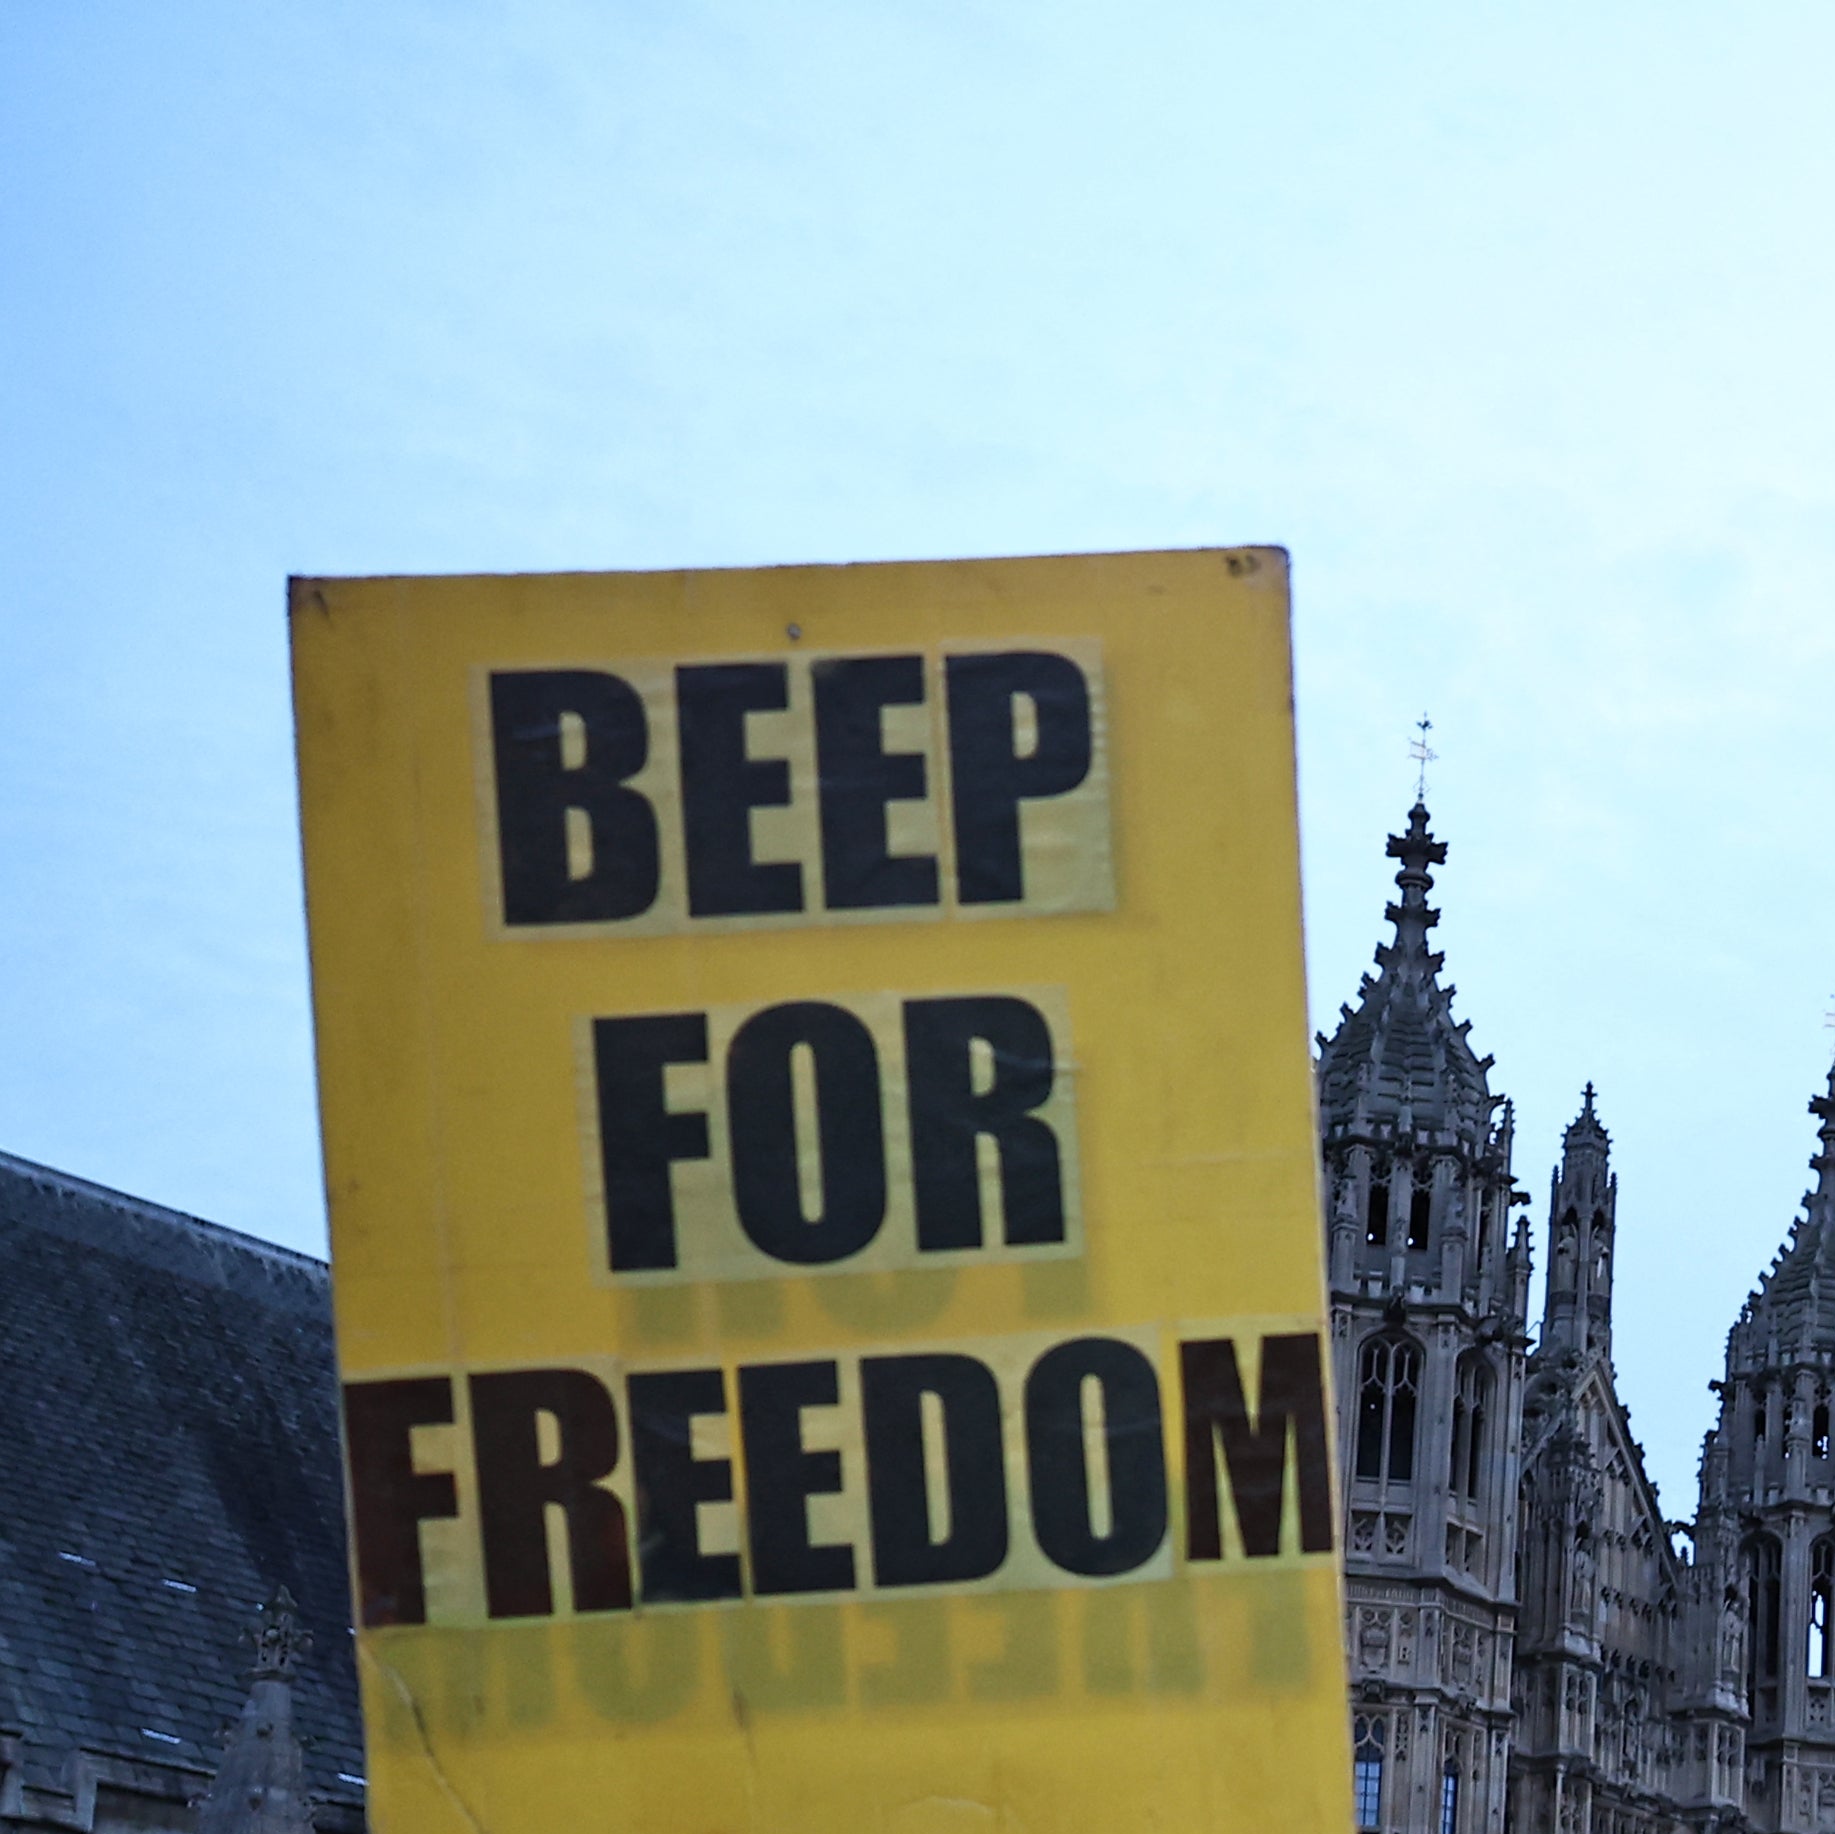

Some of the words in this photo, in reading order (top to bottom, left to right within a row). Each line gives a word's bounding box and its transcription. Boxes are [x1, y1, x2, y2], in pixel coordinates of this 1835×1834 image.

[488, 650, 1092, 925] BEEP
[590, 995, 1065, 1272] FOR
[344, 1332, 1333, 1627] FREEDOM
